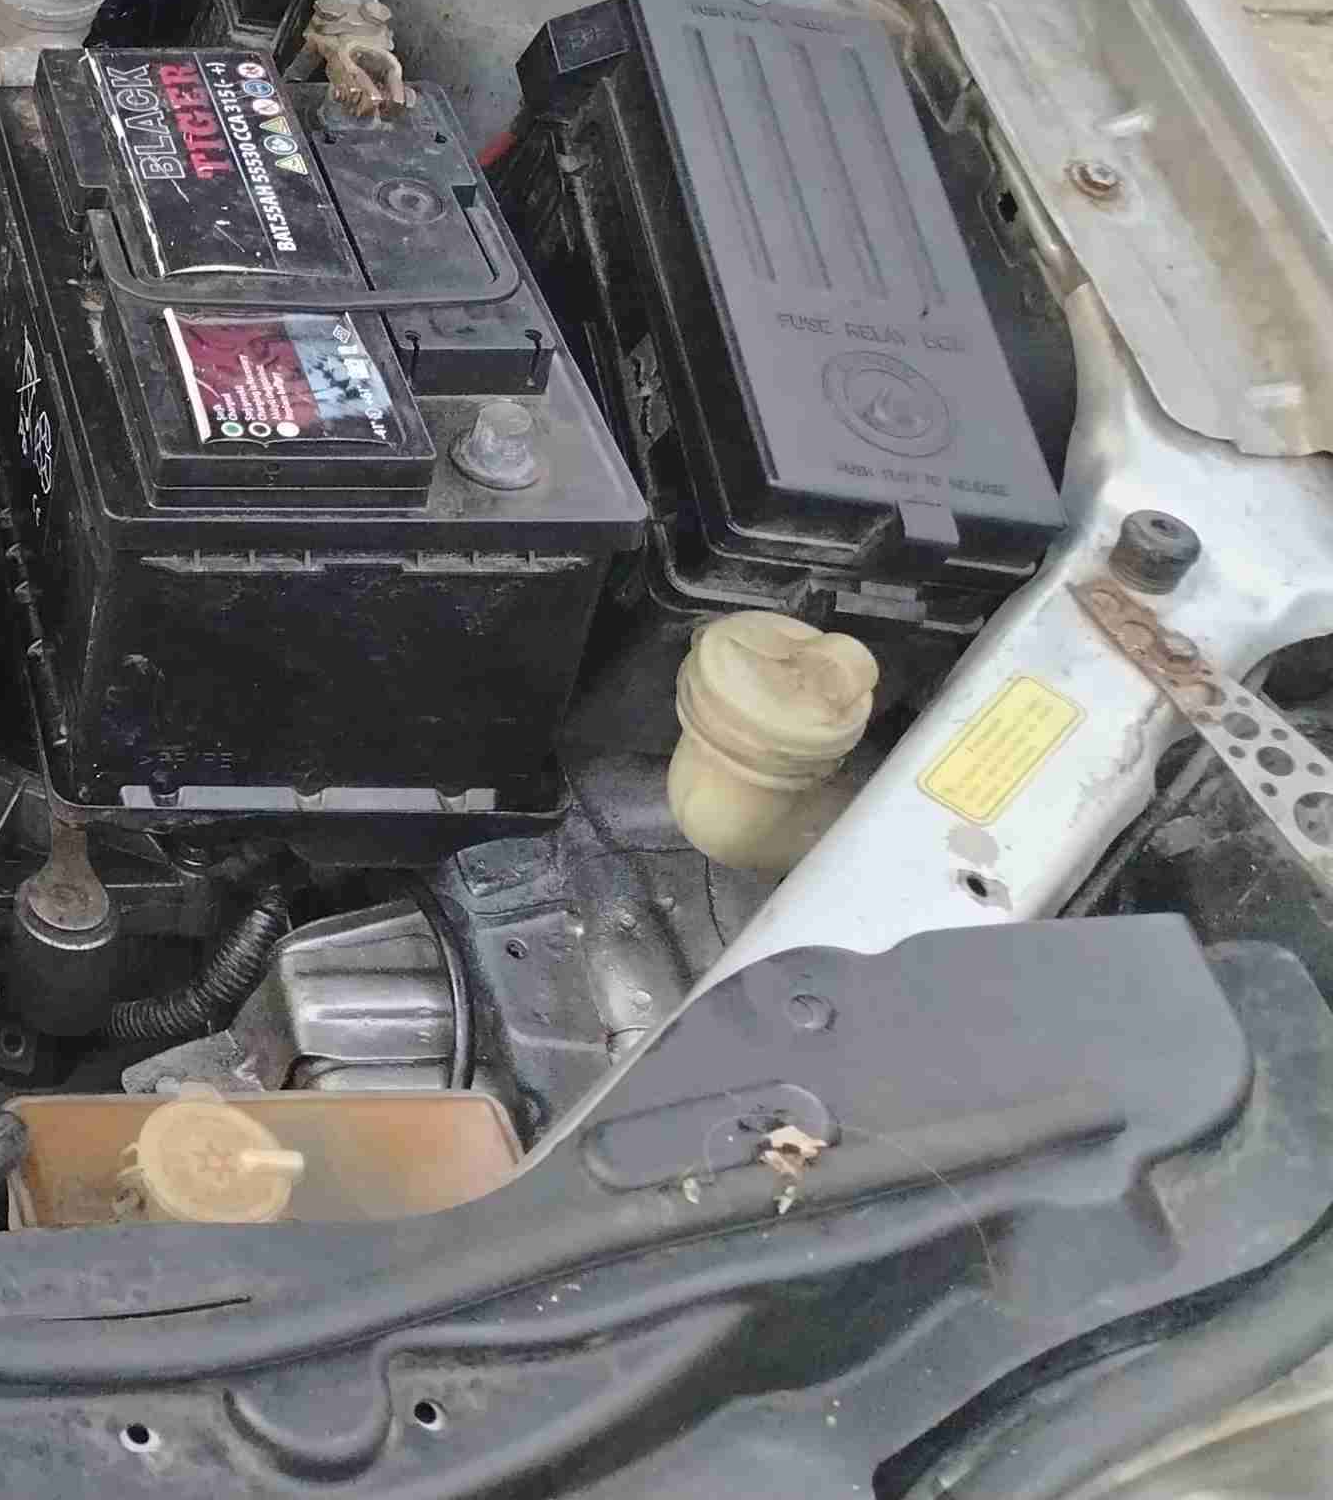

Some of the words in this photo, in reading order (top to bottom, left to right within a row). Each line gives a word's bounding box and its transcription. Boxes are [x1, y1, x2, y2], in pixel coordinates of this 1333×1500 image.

[159, 62, 232, 181] TIGER
[217, 90, 242, 113] 315
[106, 63, 186, 181] BLACK
[227, 114, 252, 141] CCA
[238, 143, 270, 183] 55530
